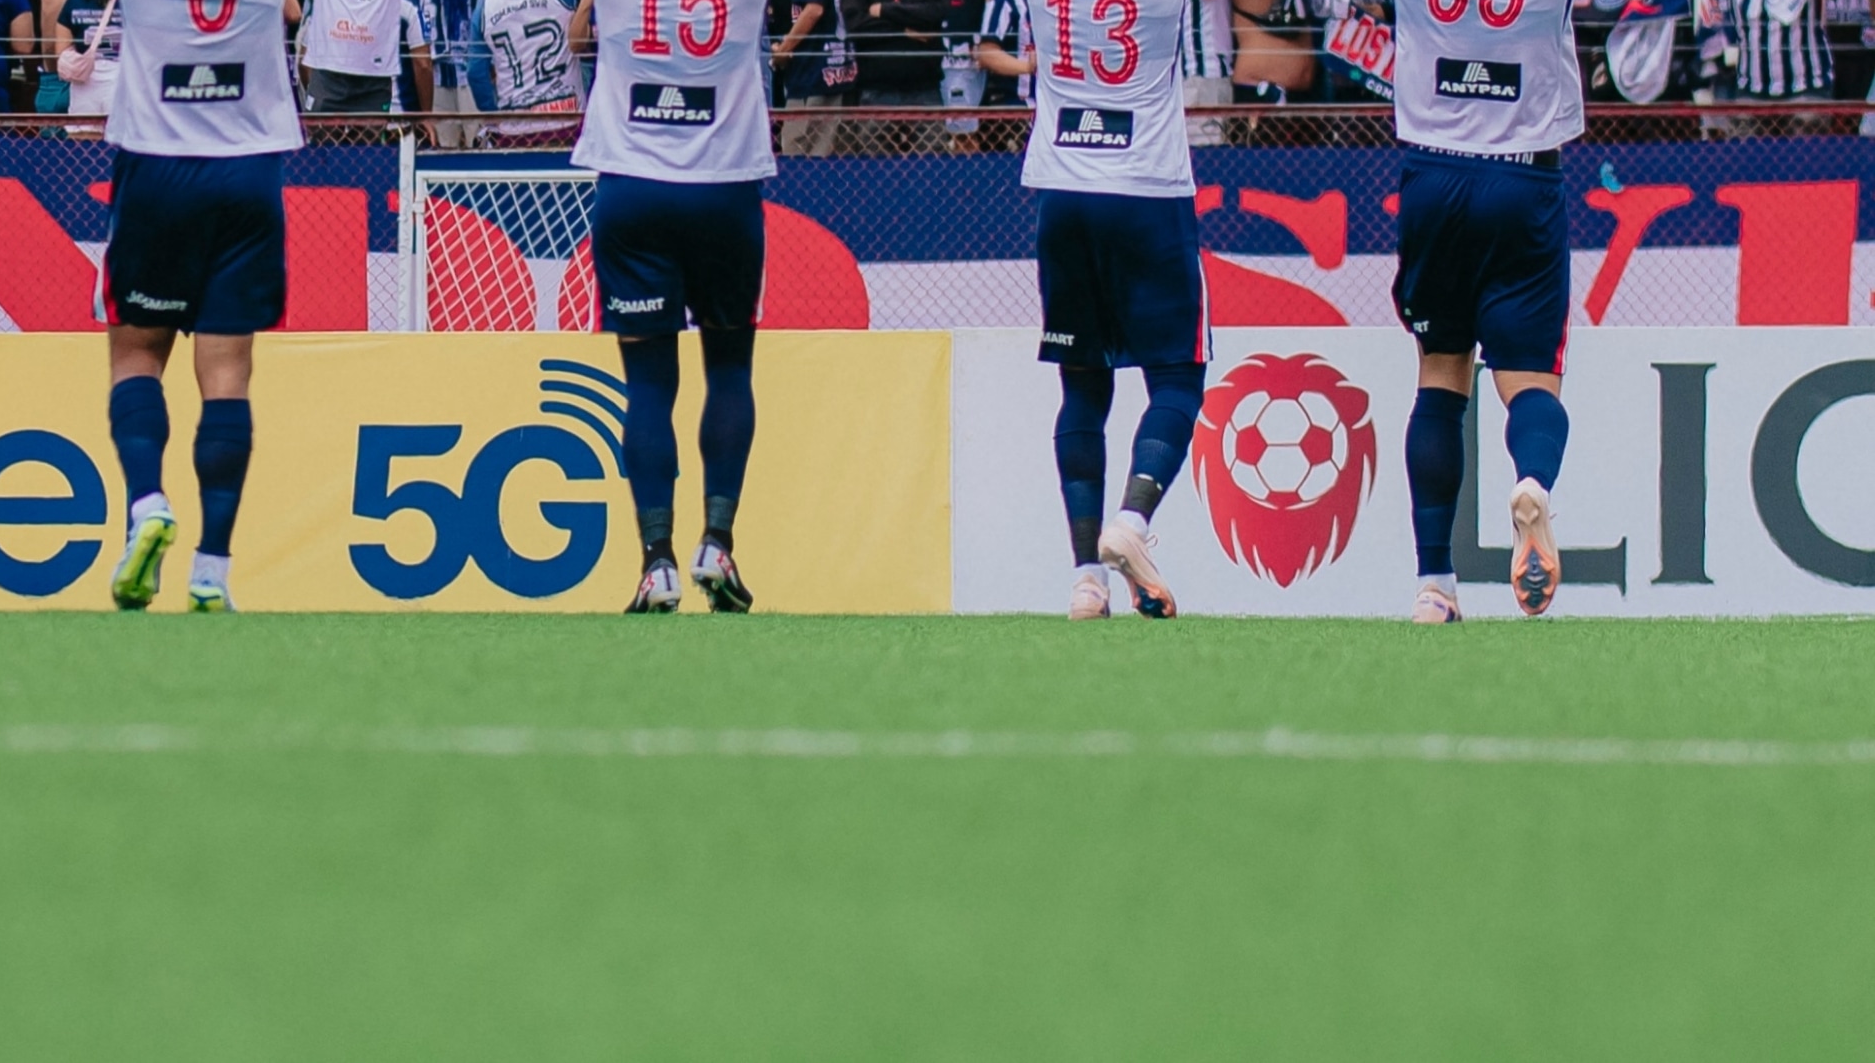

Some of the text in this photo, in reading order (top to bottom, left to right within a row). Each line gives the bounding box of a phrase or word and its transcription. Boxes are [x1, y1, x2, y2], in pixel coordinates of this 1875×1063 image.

[491, 18, 567, 89] 12
[165, 84, 241, 101] ANYPSA
[1439, 81, 1516, 97] ANYPSA
[633, 106, 712, 122] ANYPSA
[1059, 131, 1128, 146] ANYPSA
[348, 424, 608, 598] 5G
